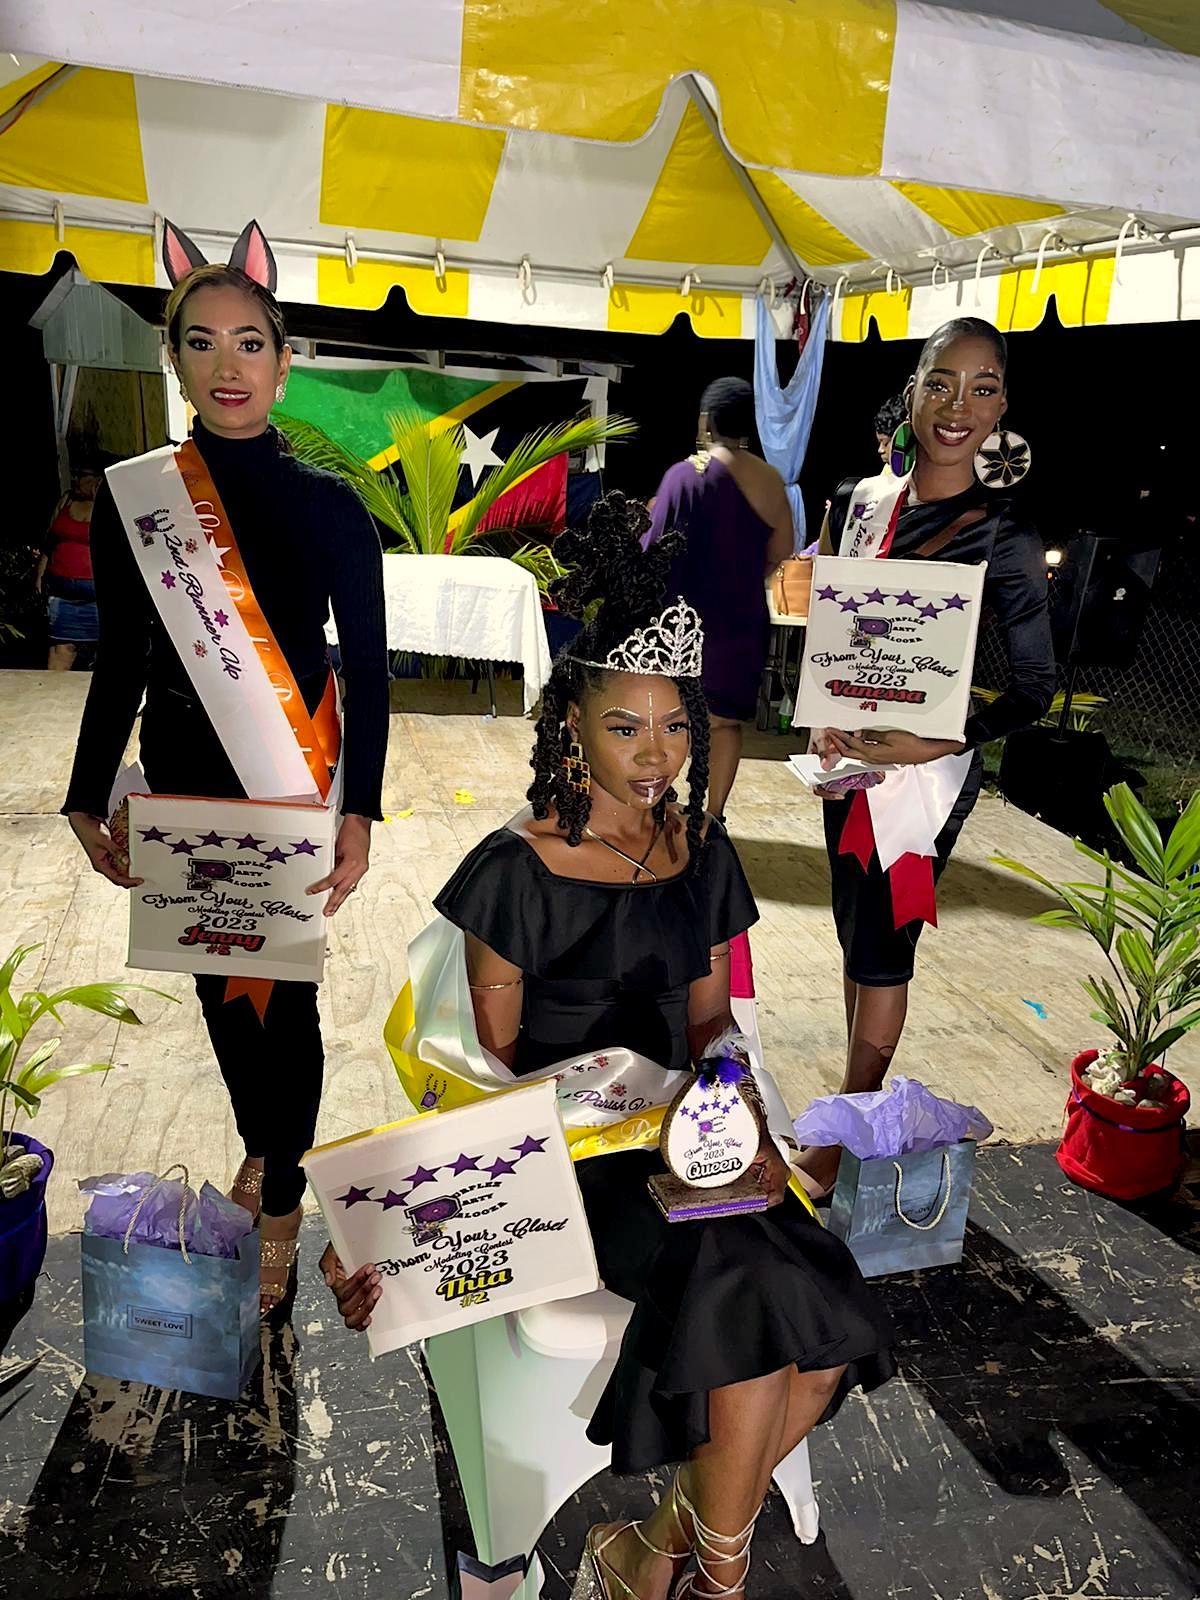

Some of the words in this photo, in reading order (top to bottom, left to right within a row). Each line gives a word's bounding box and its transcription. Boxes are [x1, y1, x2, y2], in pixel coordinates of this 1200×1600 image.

[164, 533, 189, 570] 2nd
[179, 572, 221, 647] Runner
[217, 647, 242, 681] Up
[810, 651, 857, 668] From
[860, 648, 906, 665] Your
[911, 655, 959, 678] Closet
[848, 662, 885, 673] Modeling
[885, 664, 915, 674] Contest
[854, 671, 908, 687] 2023
[825, 679, 927, 704] Vanessa
[859, 700, 878, 712] #1
[142, 892, 197, 909] From
[200, 890, 254, 909] Your
[261, 899, 315, 923] Closet
[188, 906, 230, 917] Modeling
[231, 908, 266, 918] Contest
[196, 914, 258, 931] 2023
[178, 925, 266, 952] Jenny
[573, 1089, 626, 1111] Parish
[703, 1149, 725, 1161] 2023
[686, 1157, 743, 1180] Queen
[374, 1251, 431, 1276] From
[432, 1229, 497, 1251] Your
[503, 1217, 569, 1239] Closet
[424, 1250, 473, 1272] Modeling
[474, 1238, 515, 1256] Contest
[439, 1250, 509, 1283] 2023
[436, 1264, 514, 1302] Thia
[459, 1291, 490, 1309] #2
[135, 1317, 161, 1327] SWEET
[164, 1321, 184, 1330] LOVE
